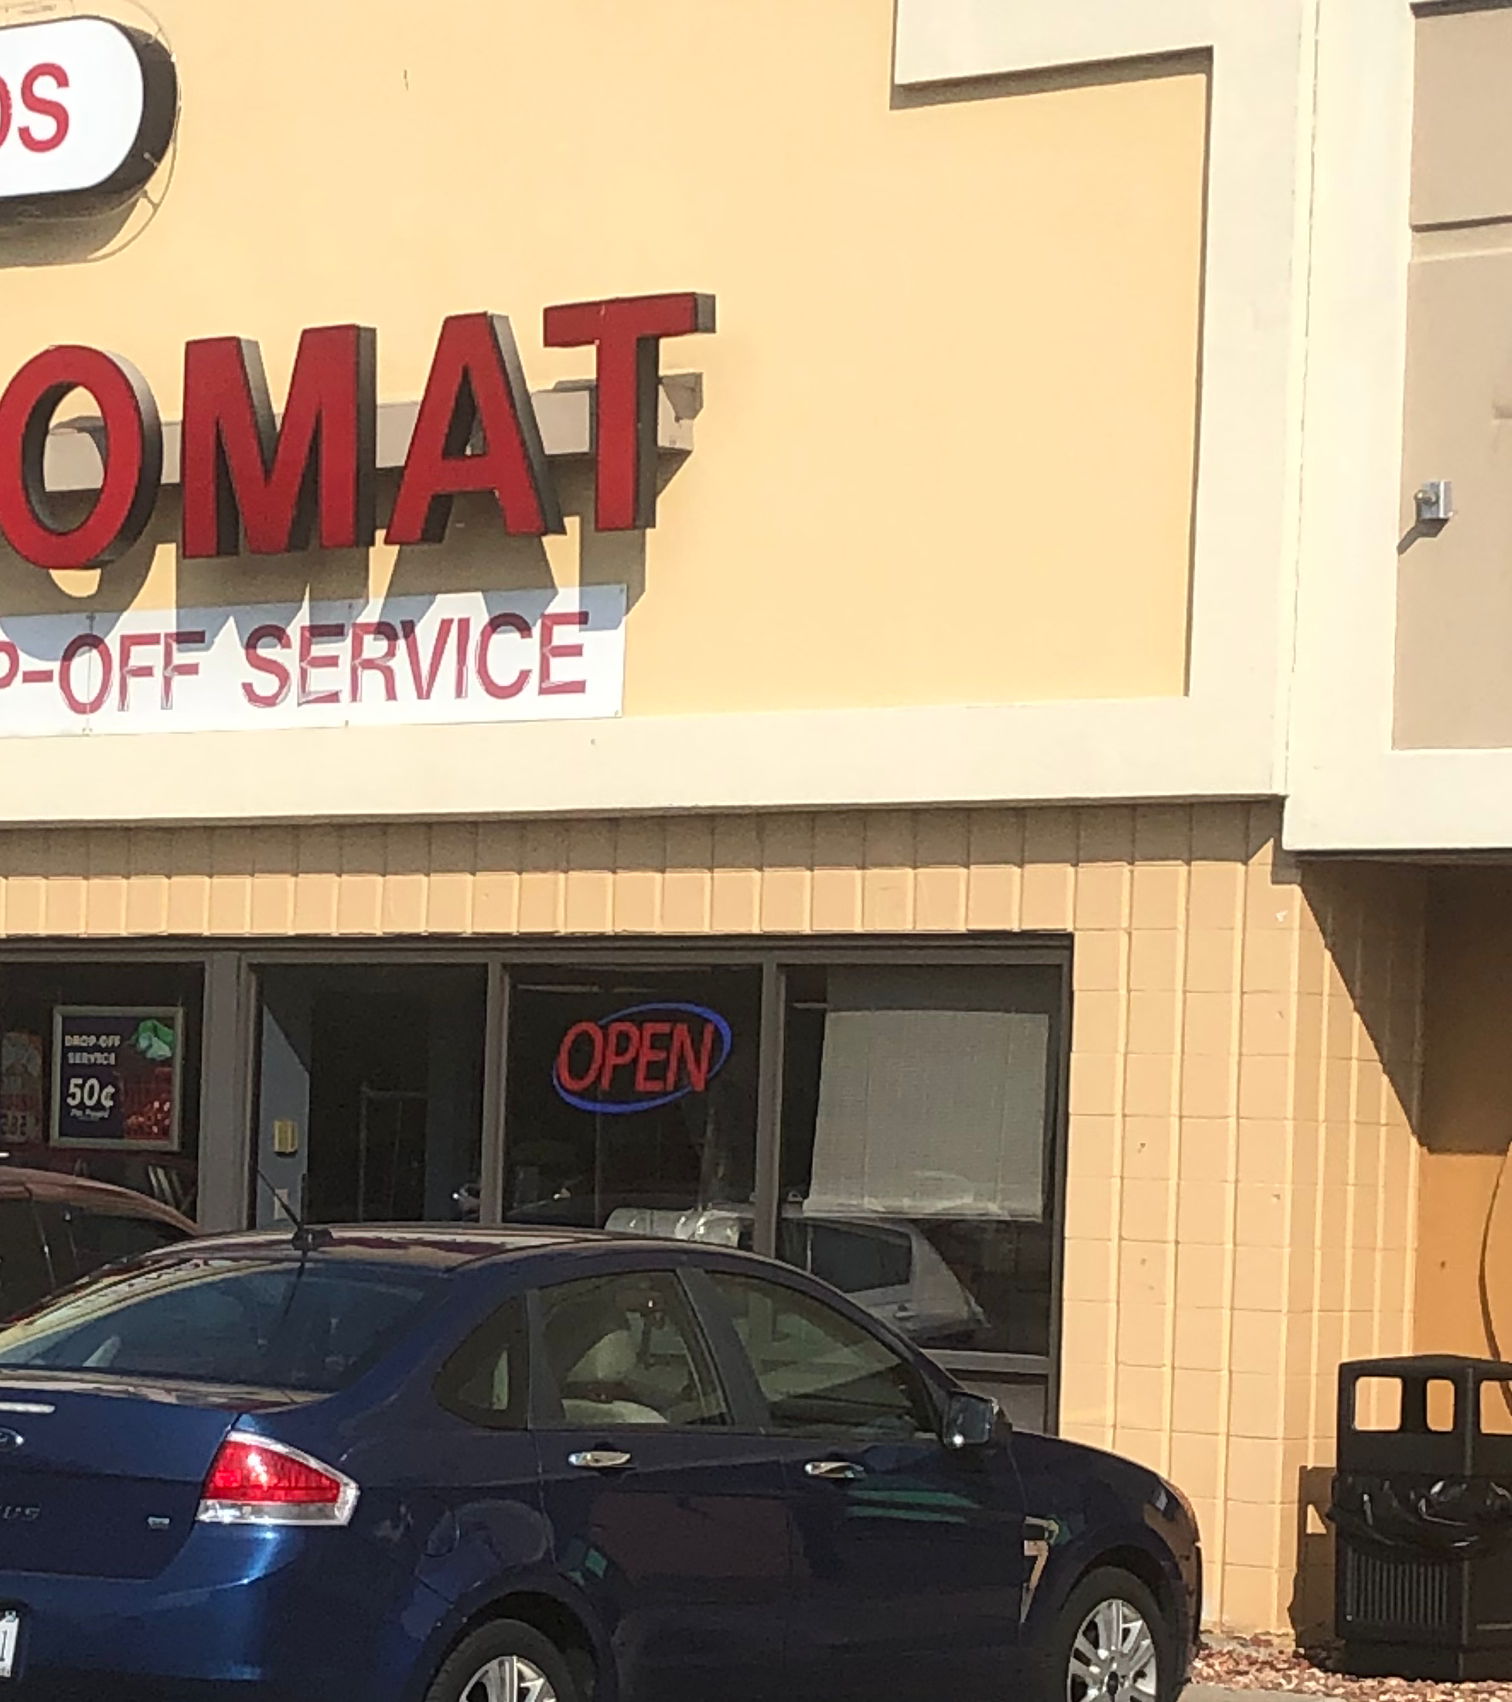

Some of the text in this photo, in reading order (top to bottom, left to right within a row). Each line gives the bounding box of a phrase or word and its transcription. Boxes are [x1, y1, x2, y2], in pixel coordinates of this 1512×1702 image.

[240, 610, 591, 708] SERVICE
[64, 1034, 122, 1047] DROP-OFF
[67, 1052, 116, 1065] SERVICE
[557, 1021, 716, 1092] OPEN
[66, 1078, 116, 1108] 50¢
